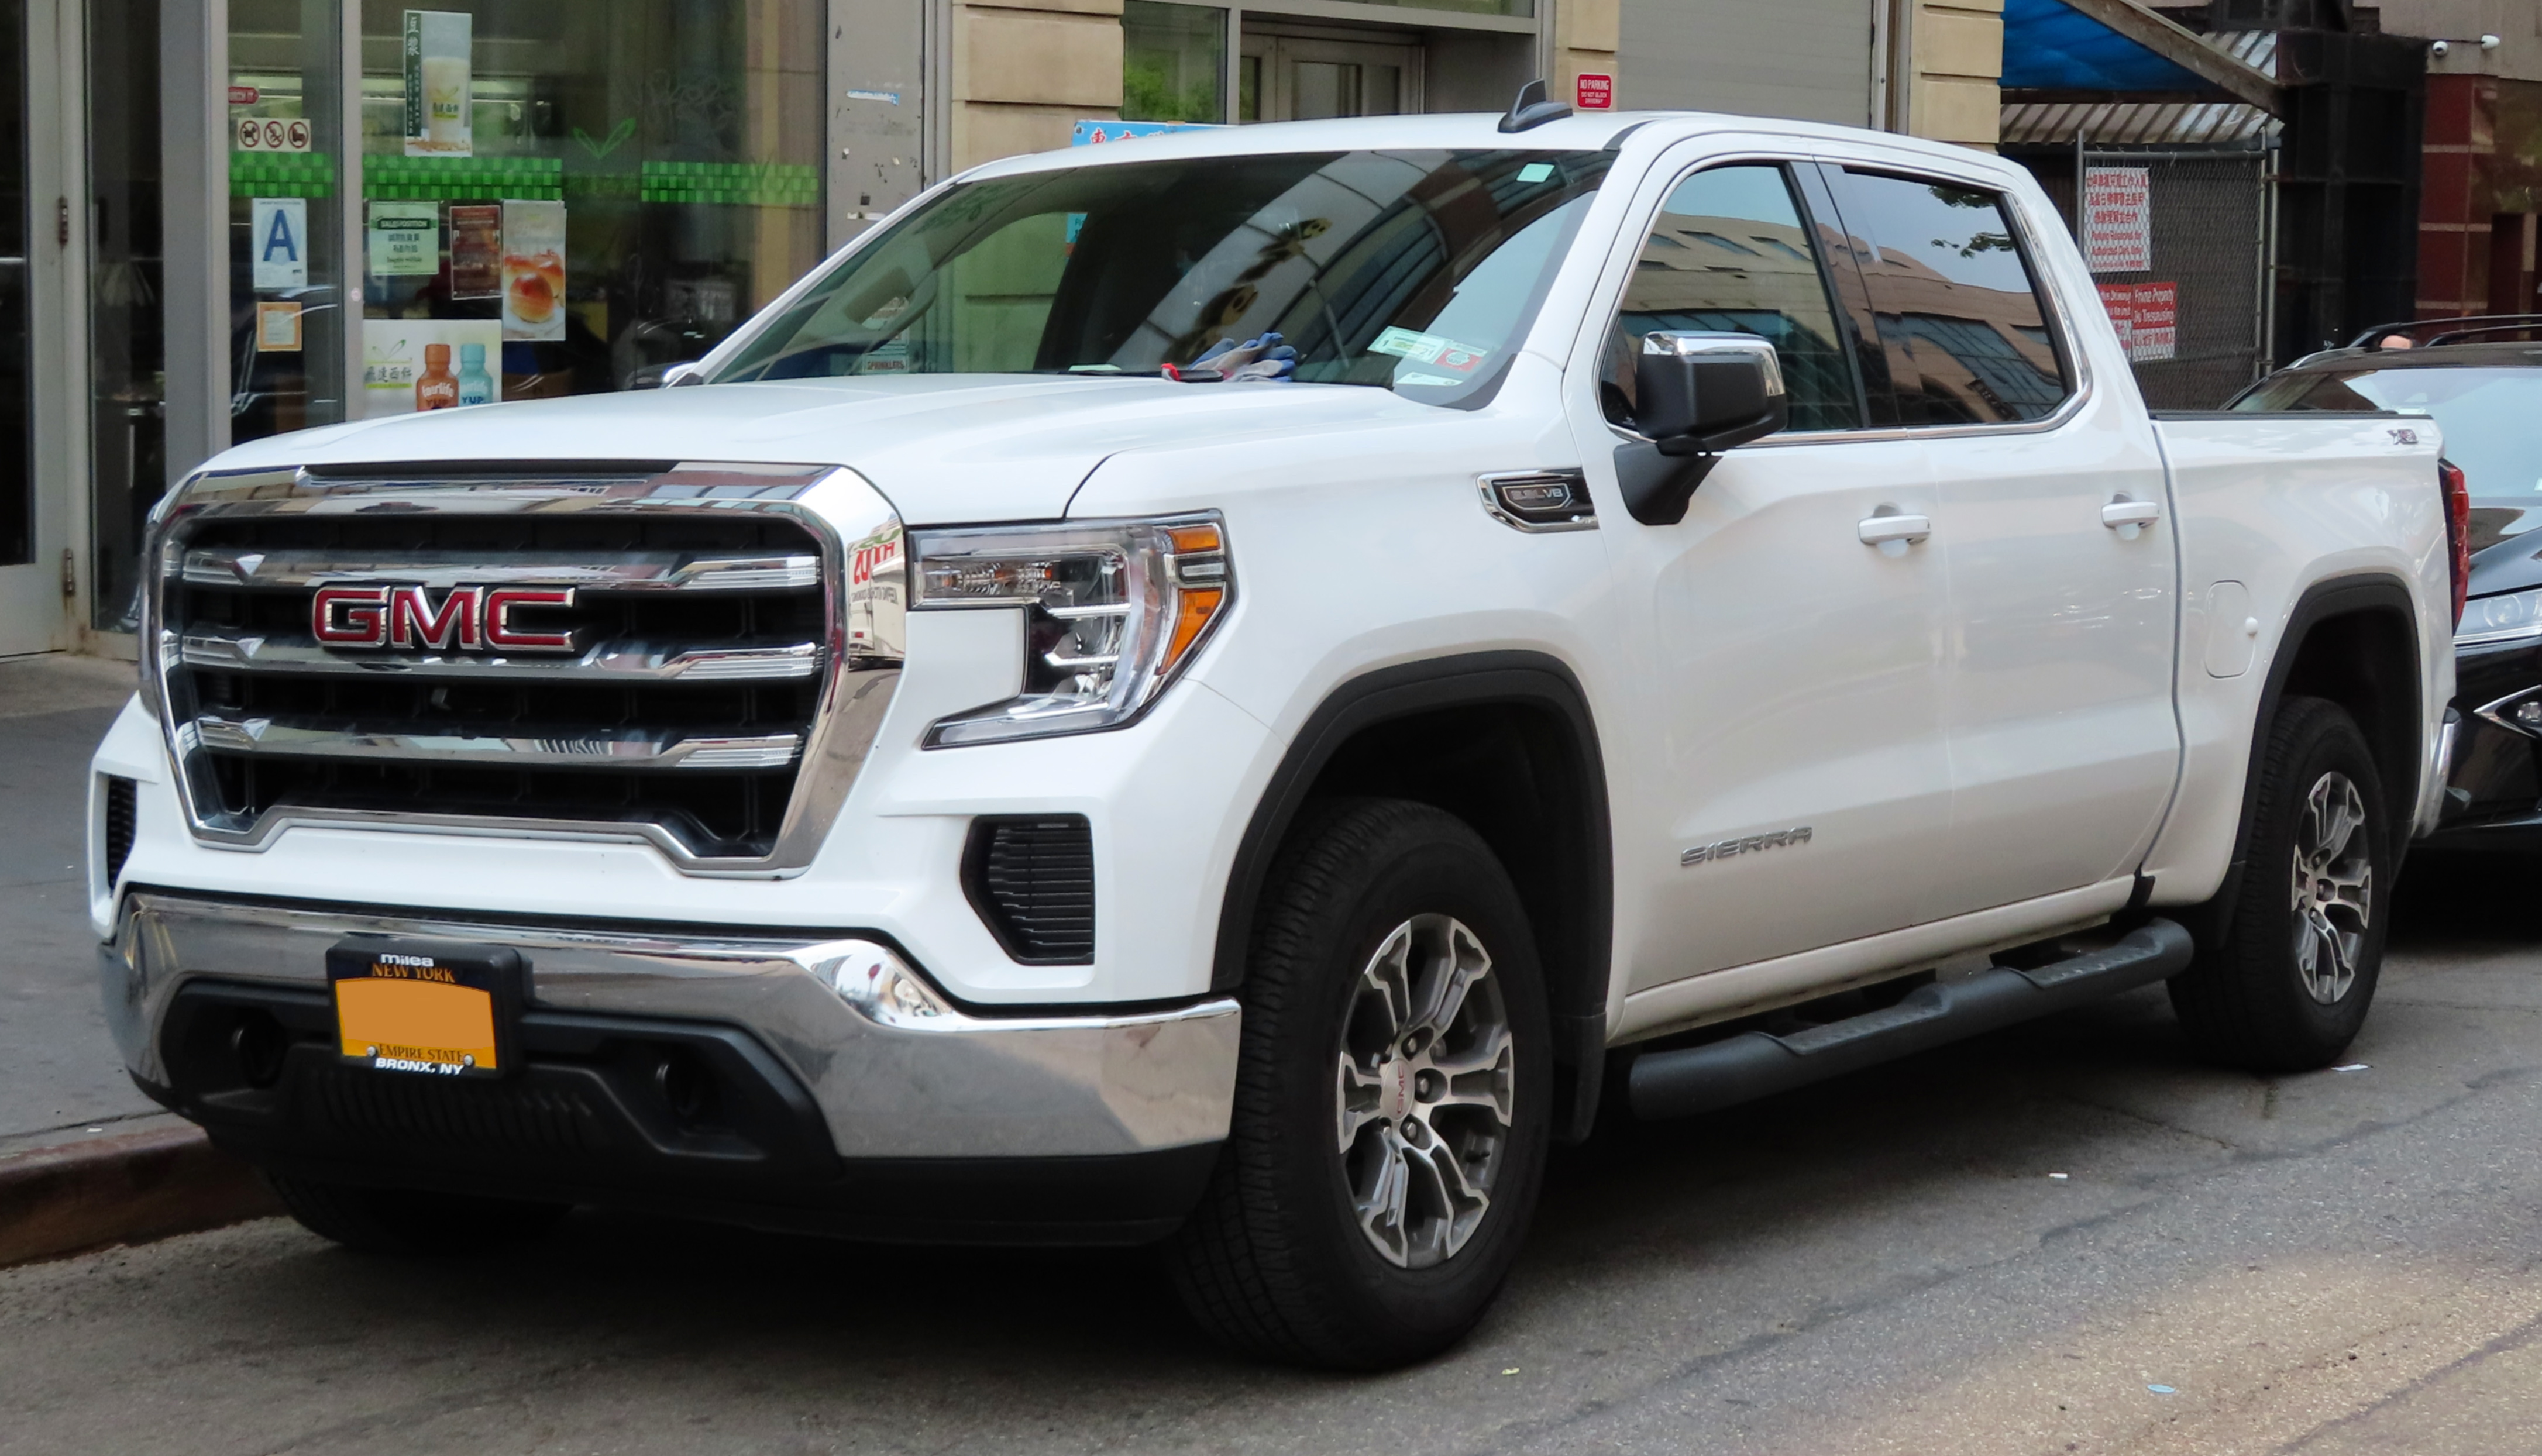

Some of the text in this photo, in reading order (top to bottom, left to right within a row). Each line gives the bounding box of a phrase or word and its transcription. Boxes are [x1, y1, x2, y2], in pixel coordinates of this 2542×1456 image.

[1580, 79, 1609, 90] NO PARKING
[263, 209, 298, 261] A
[313, 585, 575, 652] GMC
[1680, 826, 1812, 866] SIERRA
[381, 953, 434, 968] milea
[372, 963, 456, 983] NEW YORK
[378, 1043, 465, 1063] EMPIRE STATE
[374, 1057, 465, 1075] BRONX, NY
[1396, 1065, 1405, 1114] GMC
